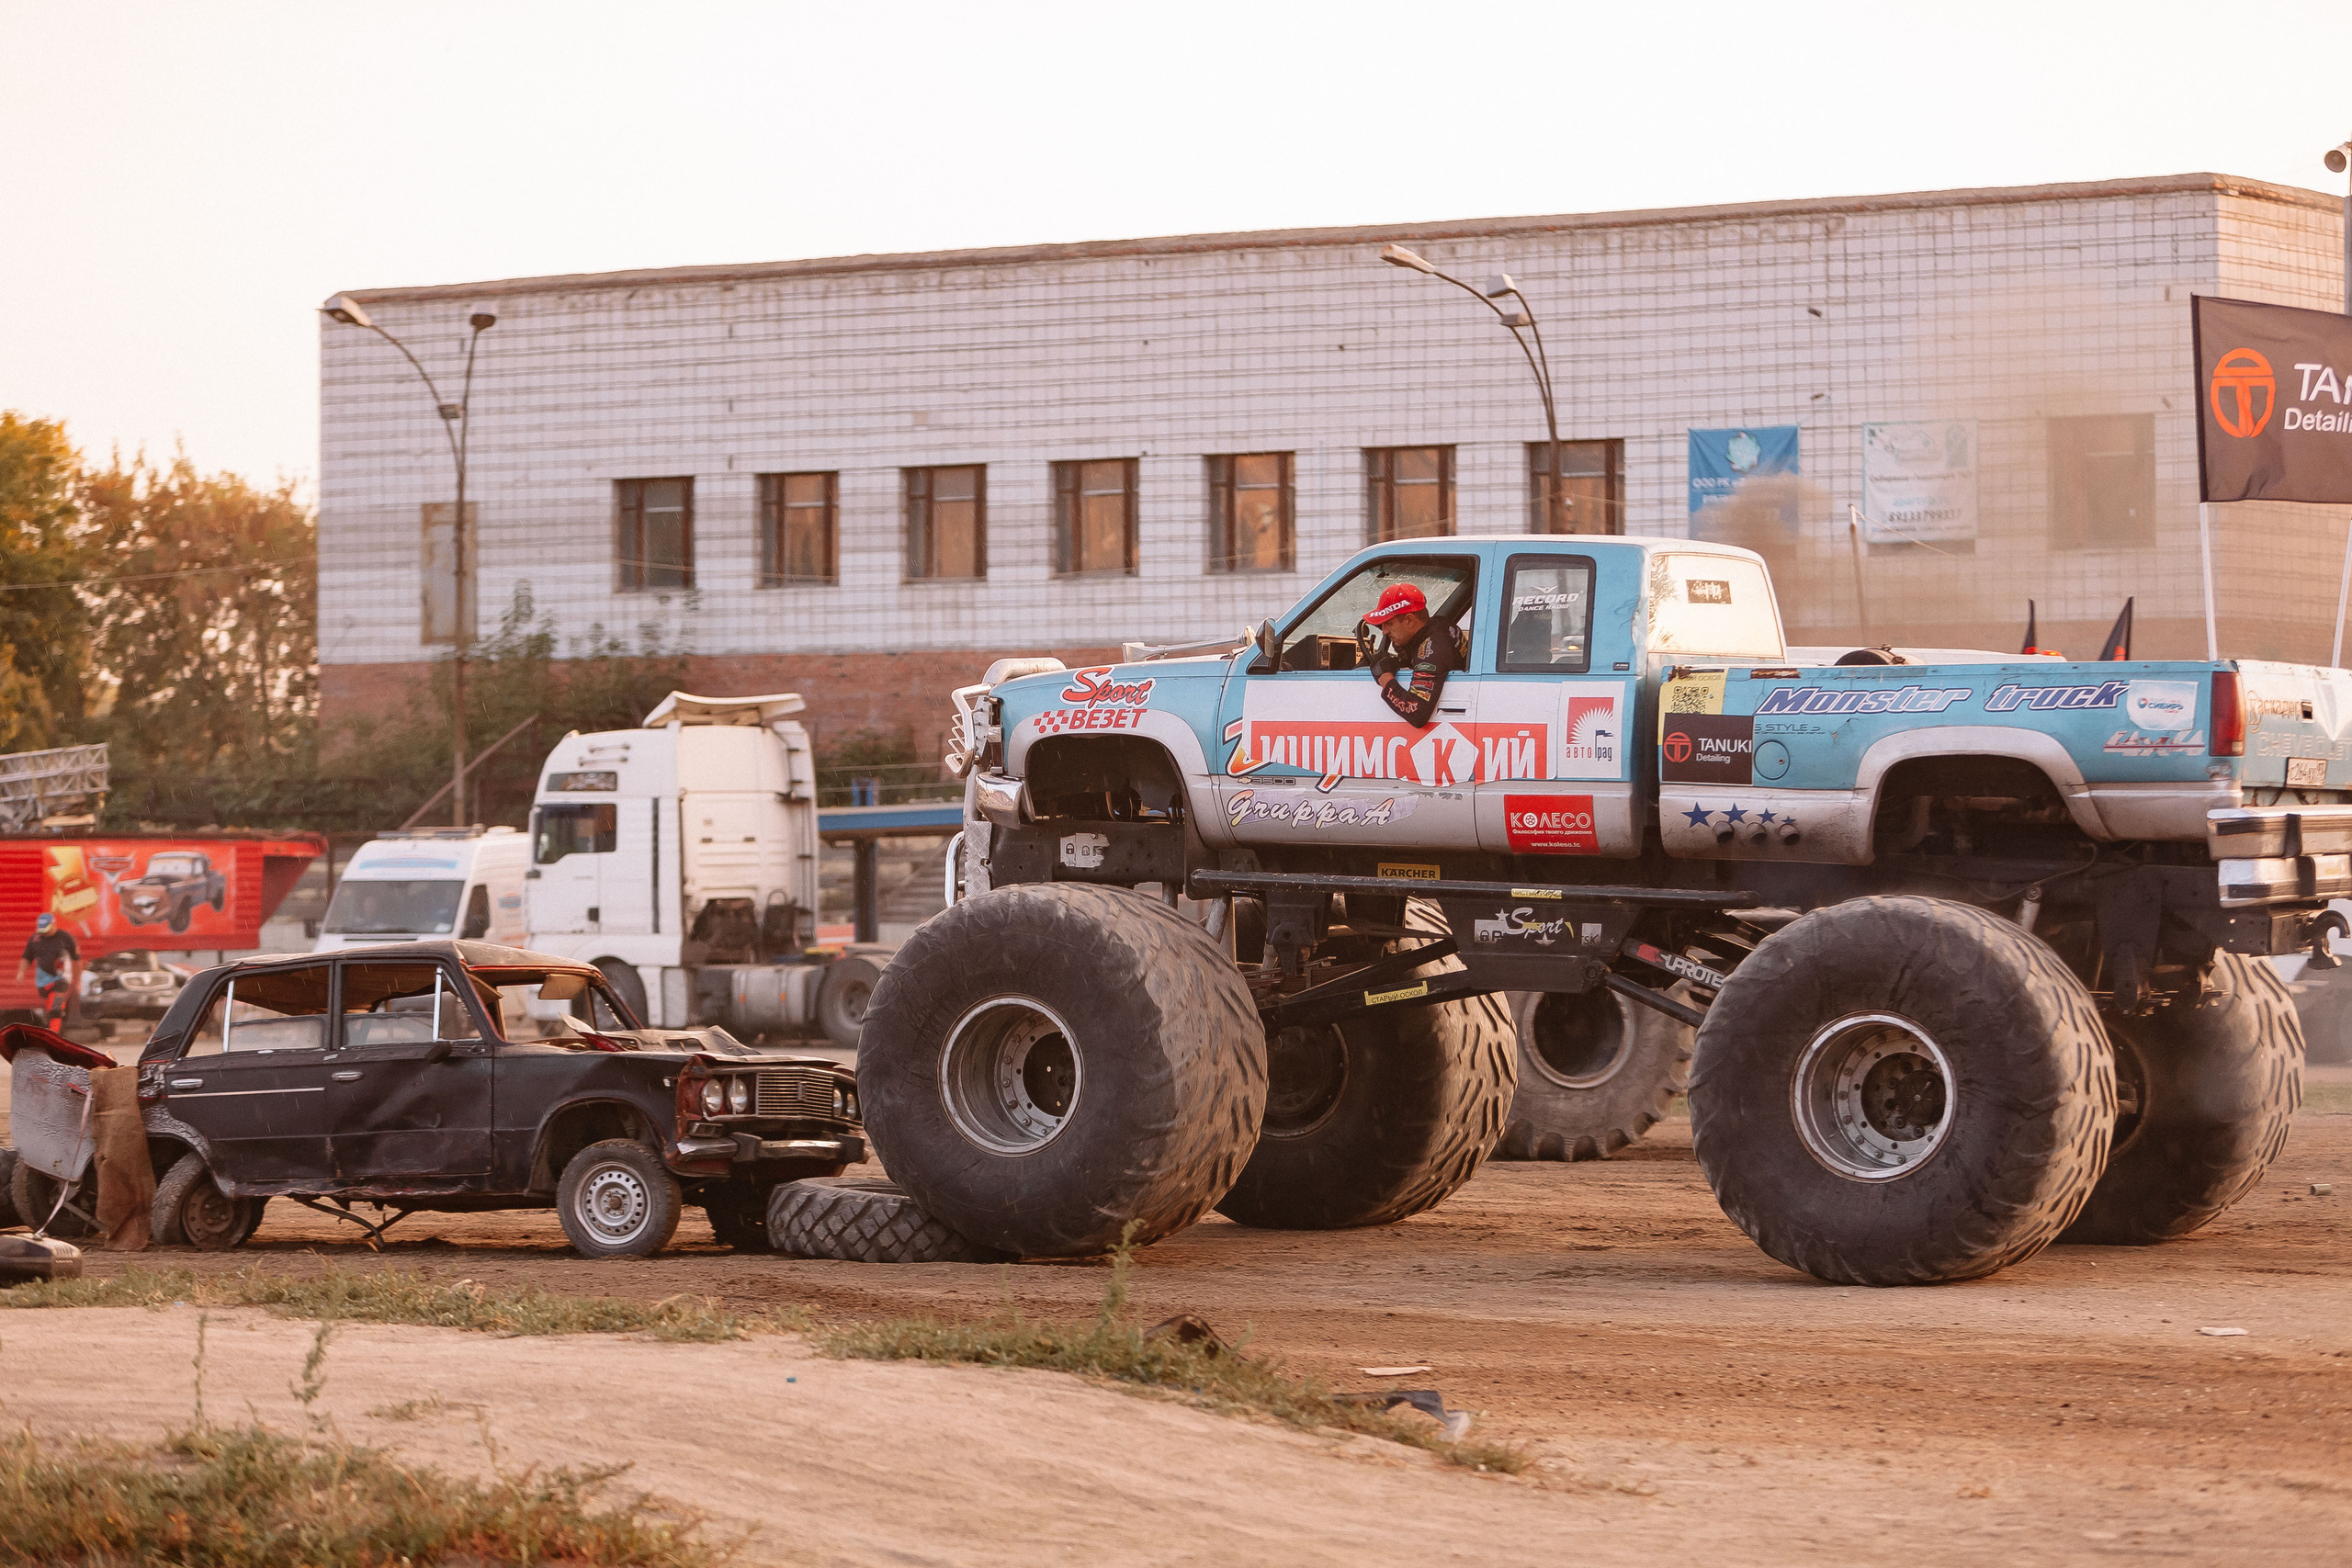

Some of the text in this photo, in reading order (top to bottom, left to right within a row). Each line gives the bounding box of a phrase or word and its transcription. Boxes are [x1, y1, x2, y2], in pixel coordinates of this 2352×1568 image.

[1512, 592, 1579, 605] RECORD
[1369, 599, 1411, 618] HONDA
[1060, 666, 1154, 710] Sport
[1753, 680, 2130, 716] Monster truck
[1069, 707, 1148, 730] ВЕЗЕТ
[1765, 723, 1808, 731] STYLE
[1698, 738, 1753, 753] TANUKI
[1696, 753, 1731, 764] Detailing
[1251, 777, 1296, 785] 3500
[1510, 812, 1591, 829] КОЛЕСО
[1506, 907, 1565, 939] Sport
[1371, 989, 1423, 1003] СТАРЫЙ ОСКОЛ
